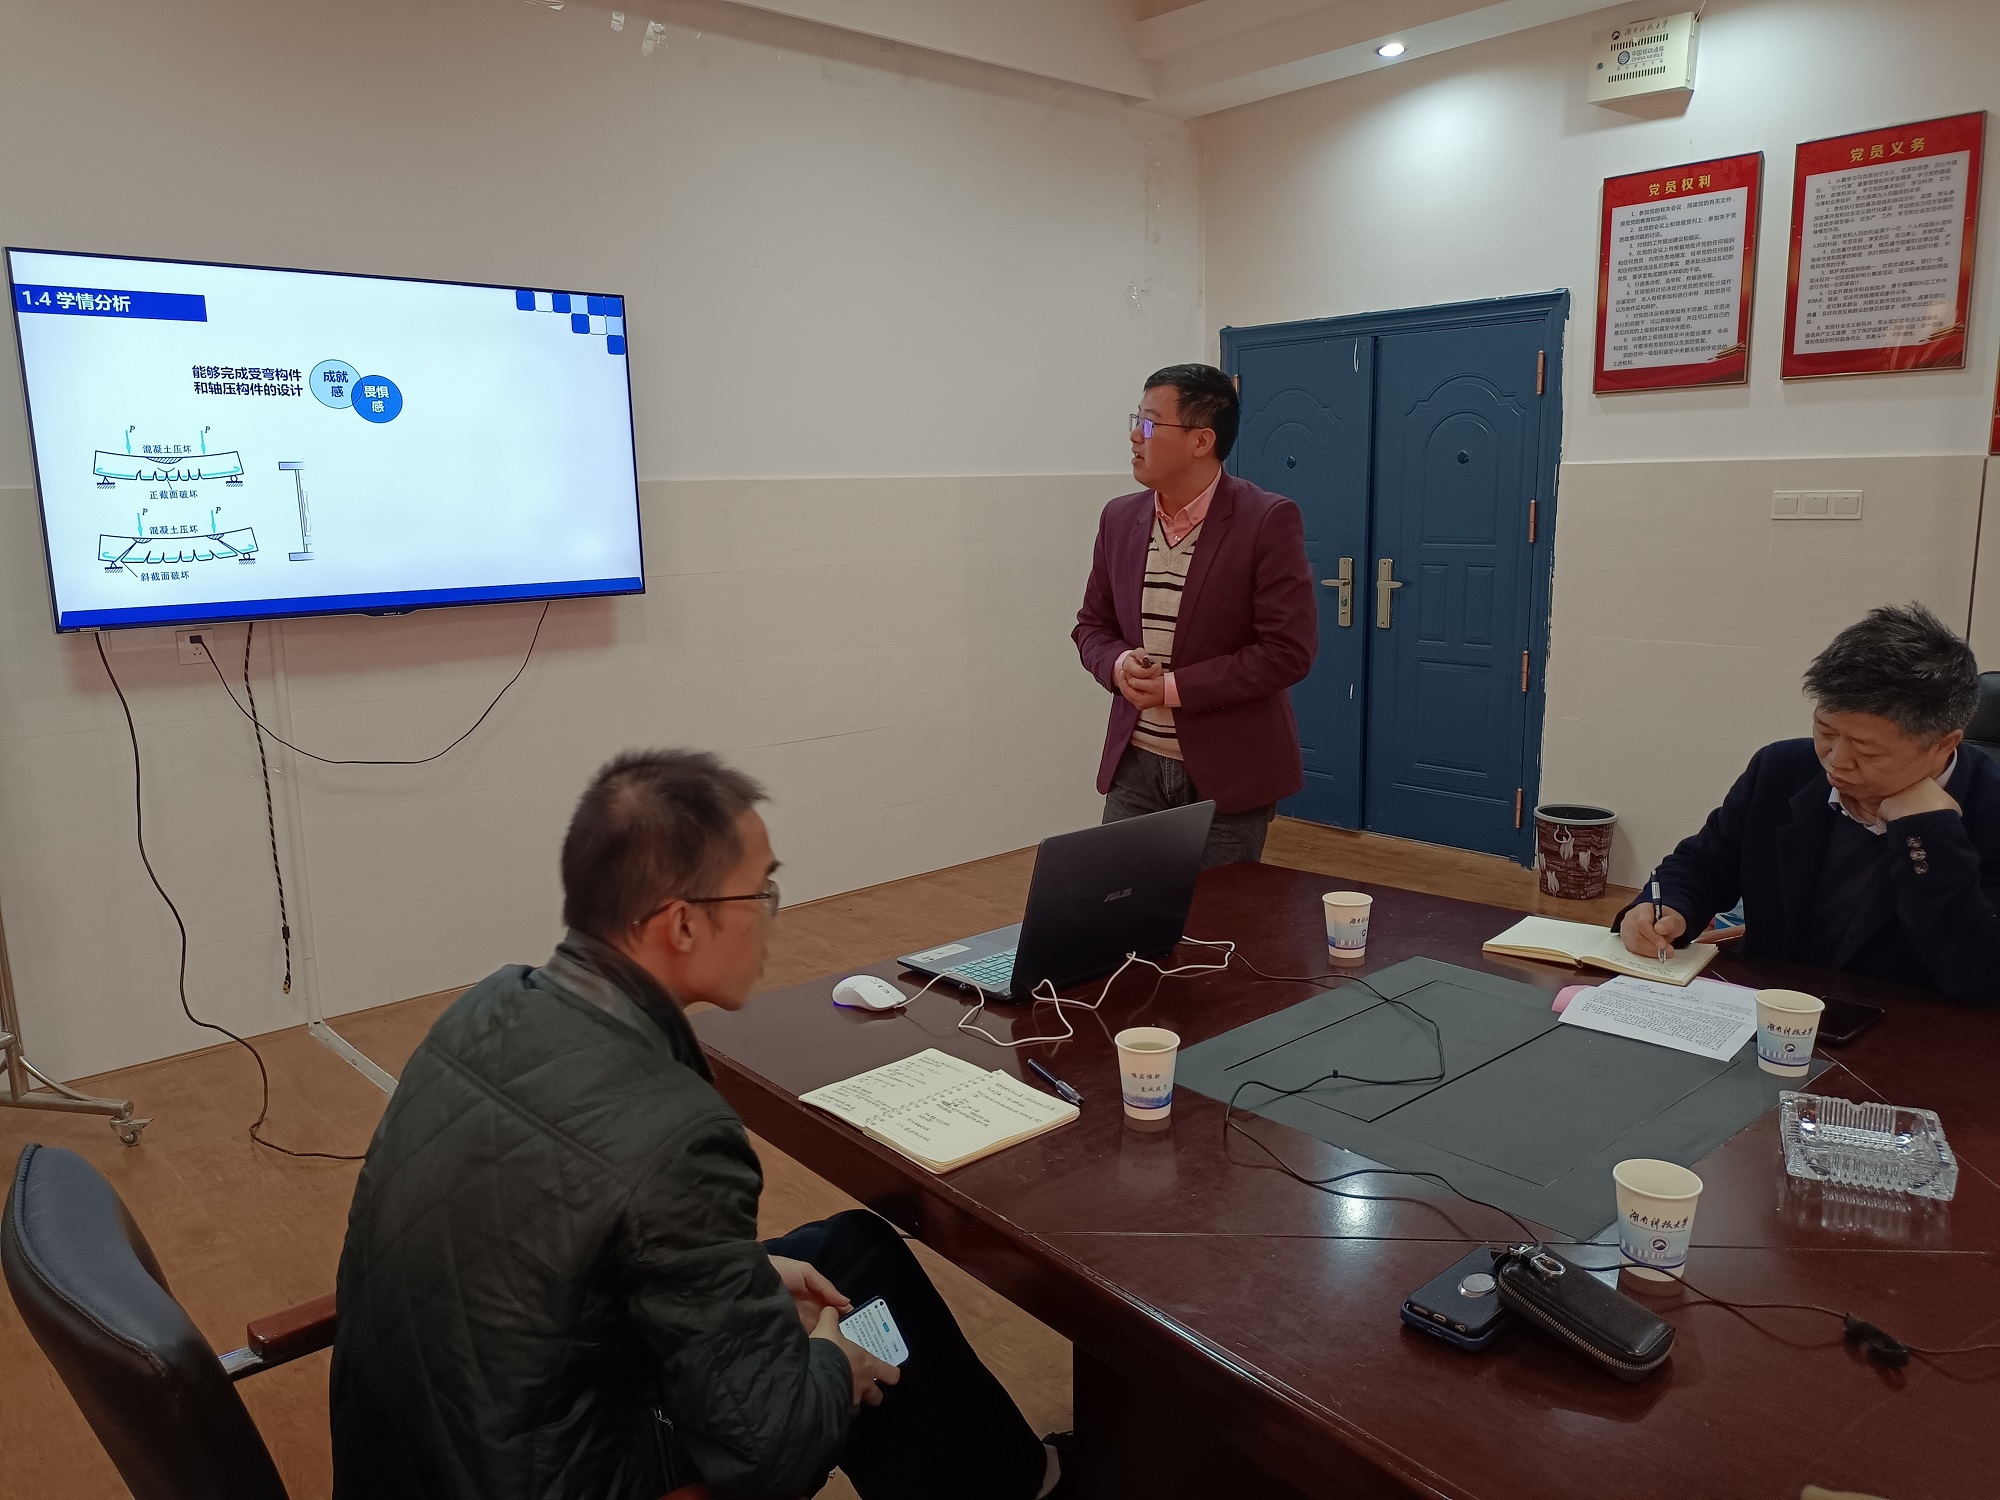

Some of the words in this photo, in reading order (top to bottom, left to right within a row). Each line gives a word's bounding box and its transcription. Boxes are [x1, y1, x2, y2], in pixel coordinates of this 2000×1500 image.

[1632, 46, 1664, 56] 中国移动通信
[1850, 137, 1925, 163] 党员义务
[1648, 174, 1711, 196] 党员权利
[22, 290, 52, 306] 1.4
[56, 292, 131, 312] 学情分析
[192, 365, 302, 382] 能够完成受弯构件
[323, 370, 349, 383] 成就
[194, 381, 303, 397] 和轴压构件的设计
[331, 386, 344, 398] 感
[364, 385, 389, 399] 畏惧
[371, 401, 385, 413] 感
[143, 444, 192, 454] 混凝土压坏
[150, 490, 198, 500] 正截面破坏
[150, 525, 198, 535] 混凝土压坏
[140, 571, 190, 582] 斜截面破坏
[1104, 888, 1132, 902] ASUS
[1767, 1021, 1814, 1036] 湖南科技大学
[1630, 1209, 1689, 1231] 湖南科技大学
